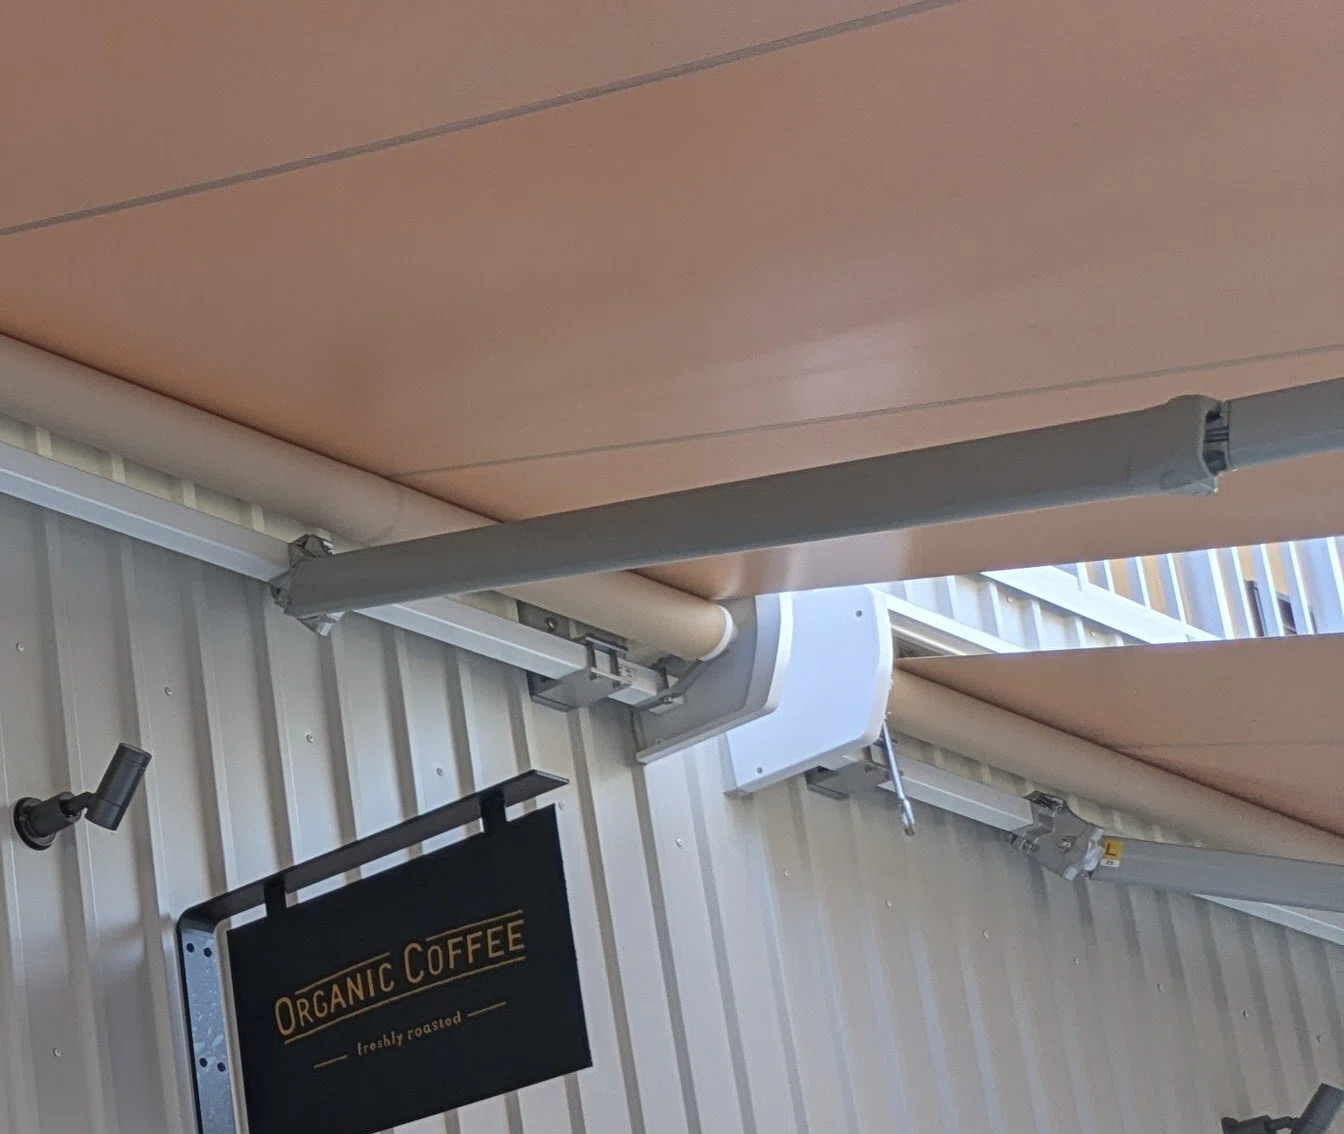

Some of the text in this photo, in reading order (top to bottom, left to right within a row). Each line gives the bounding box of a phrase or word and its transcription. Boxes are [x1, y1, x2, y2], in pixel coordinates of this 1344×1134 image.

[274, 919, 525, 1036] ORGANIC COFFEE
[357, 1011, 461, 1056] freshly roasted
